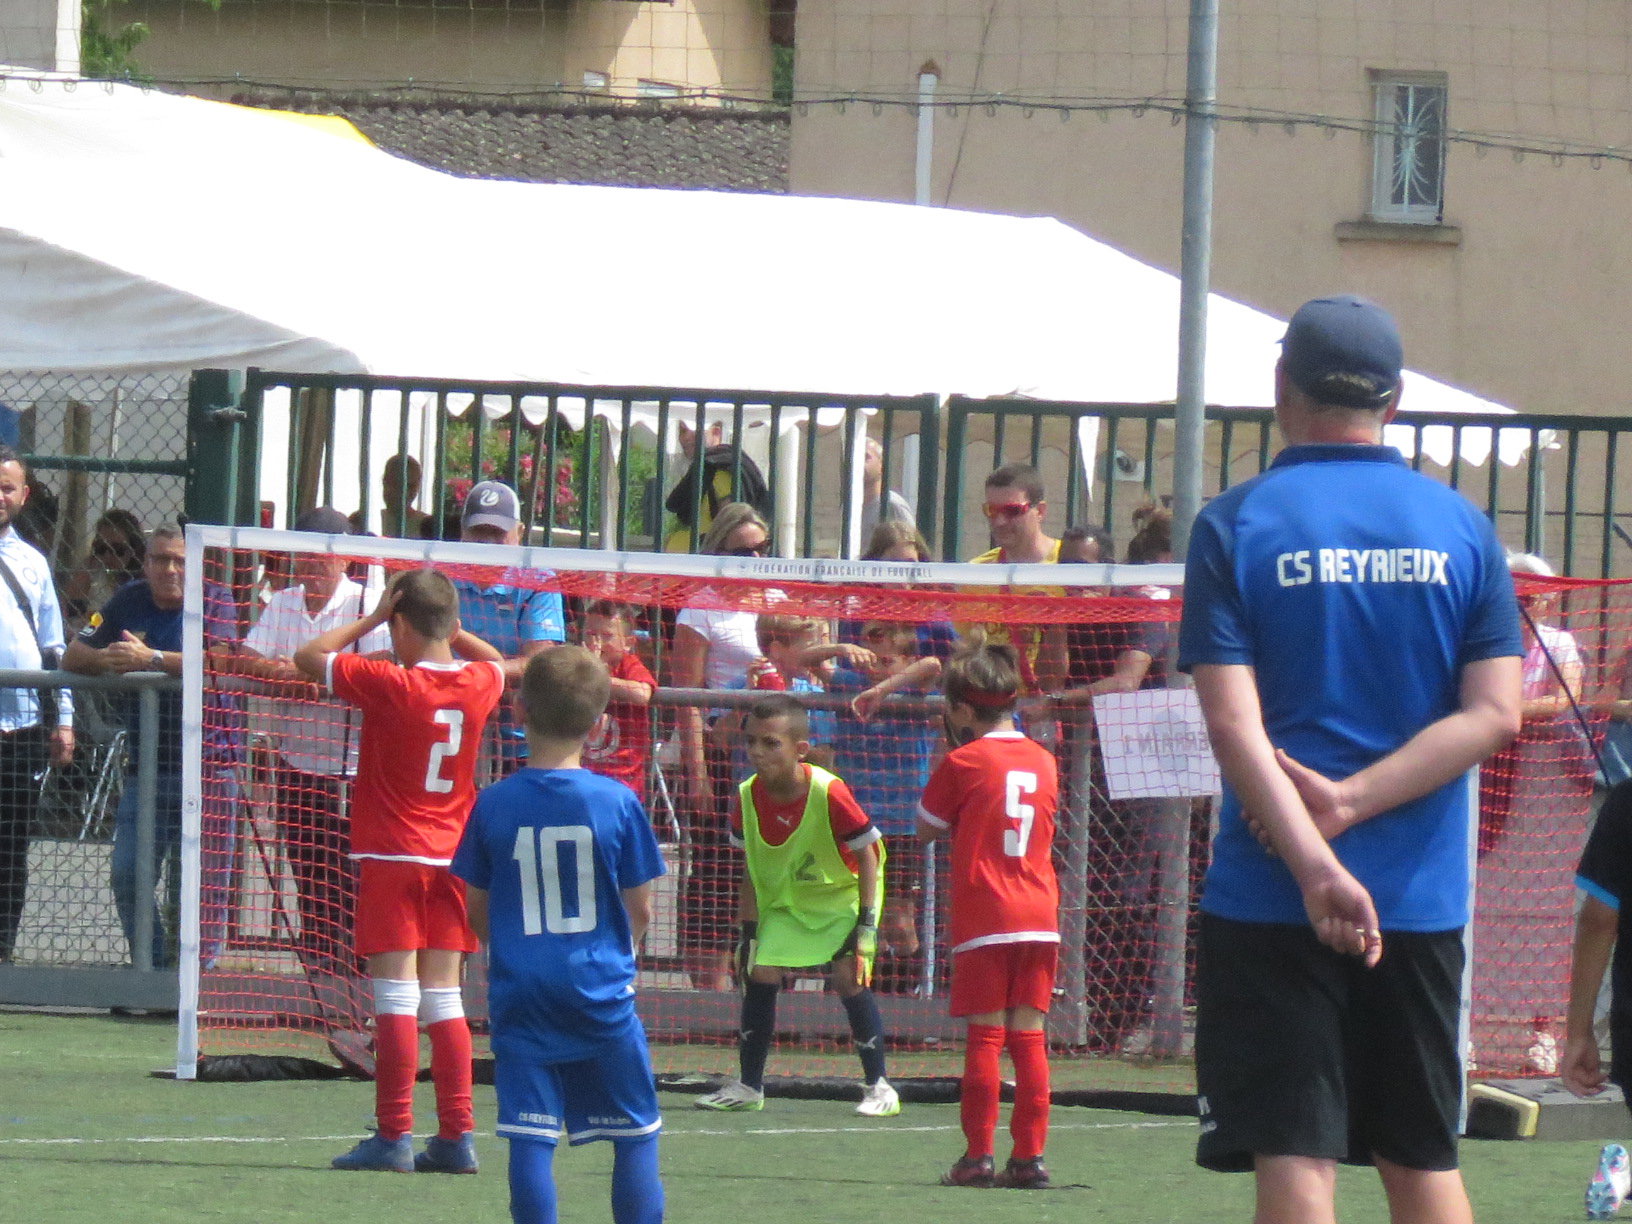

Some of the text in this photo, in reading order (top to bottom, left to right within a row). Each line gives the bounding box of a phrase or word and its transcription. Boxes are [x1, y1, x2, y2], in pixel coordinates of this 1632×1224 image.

[1277, 548, 1449, 587] CS REYRIEUX
[425, 709, 464, 793] 2
[1004, 770, 1037, 857] 5
[512, 824, 597, 935] 10
